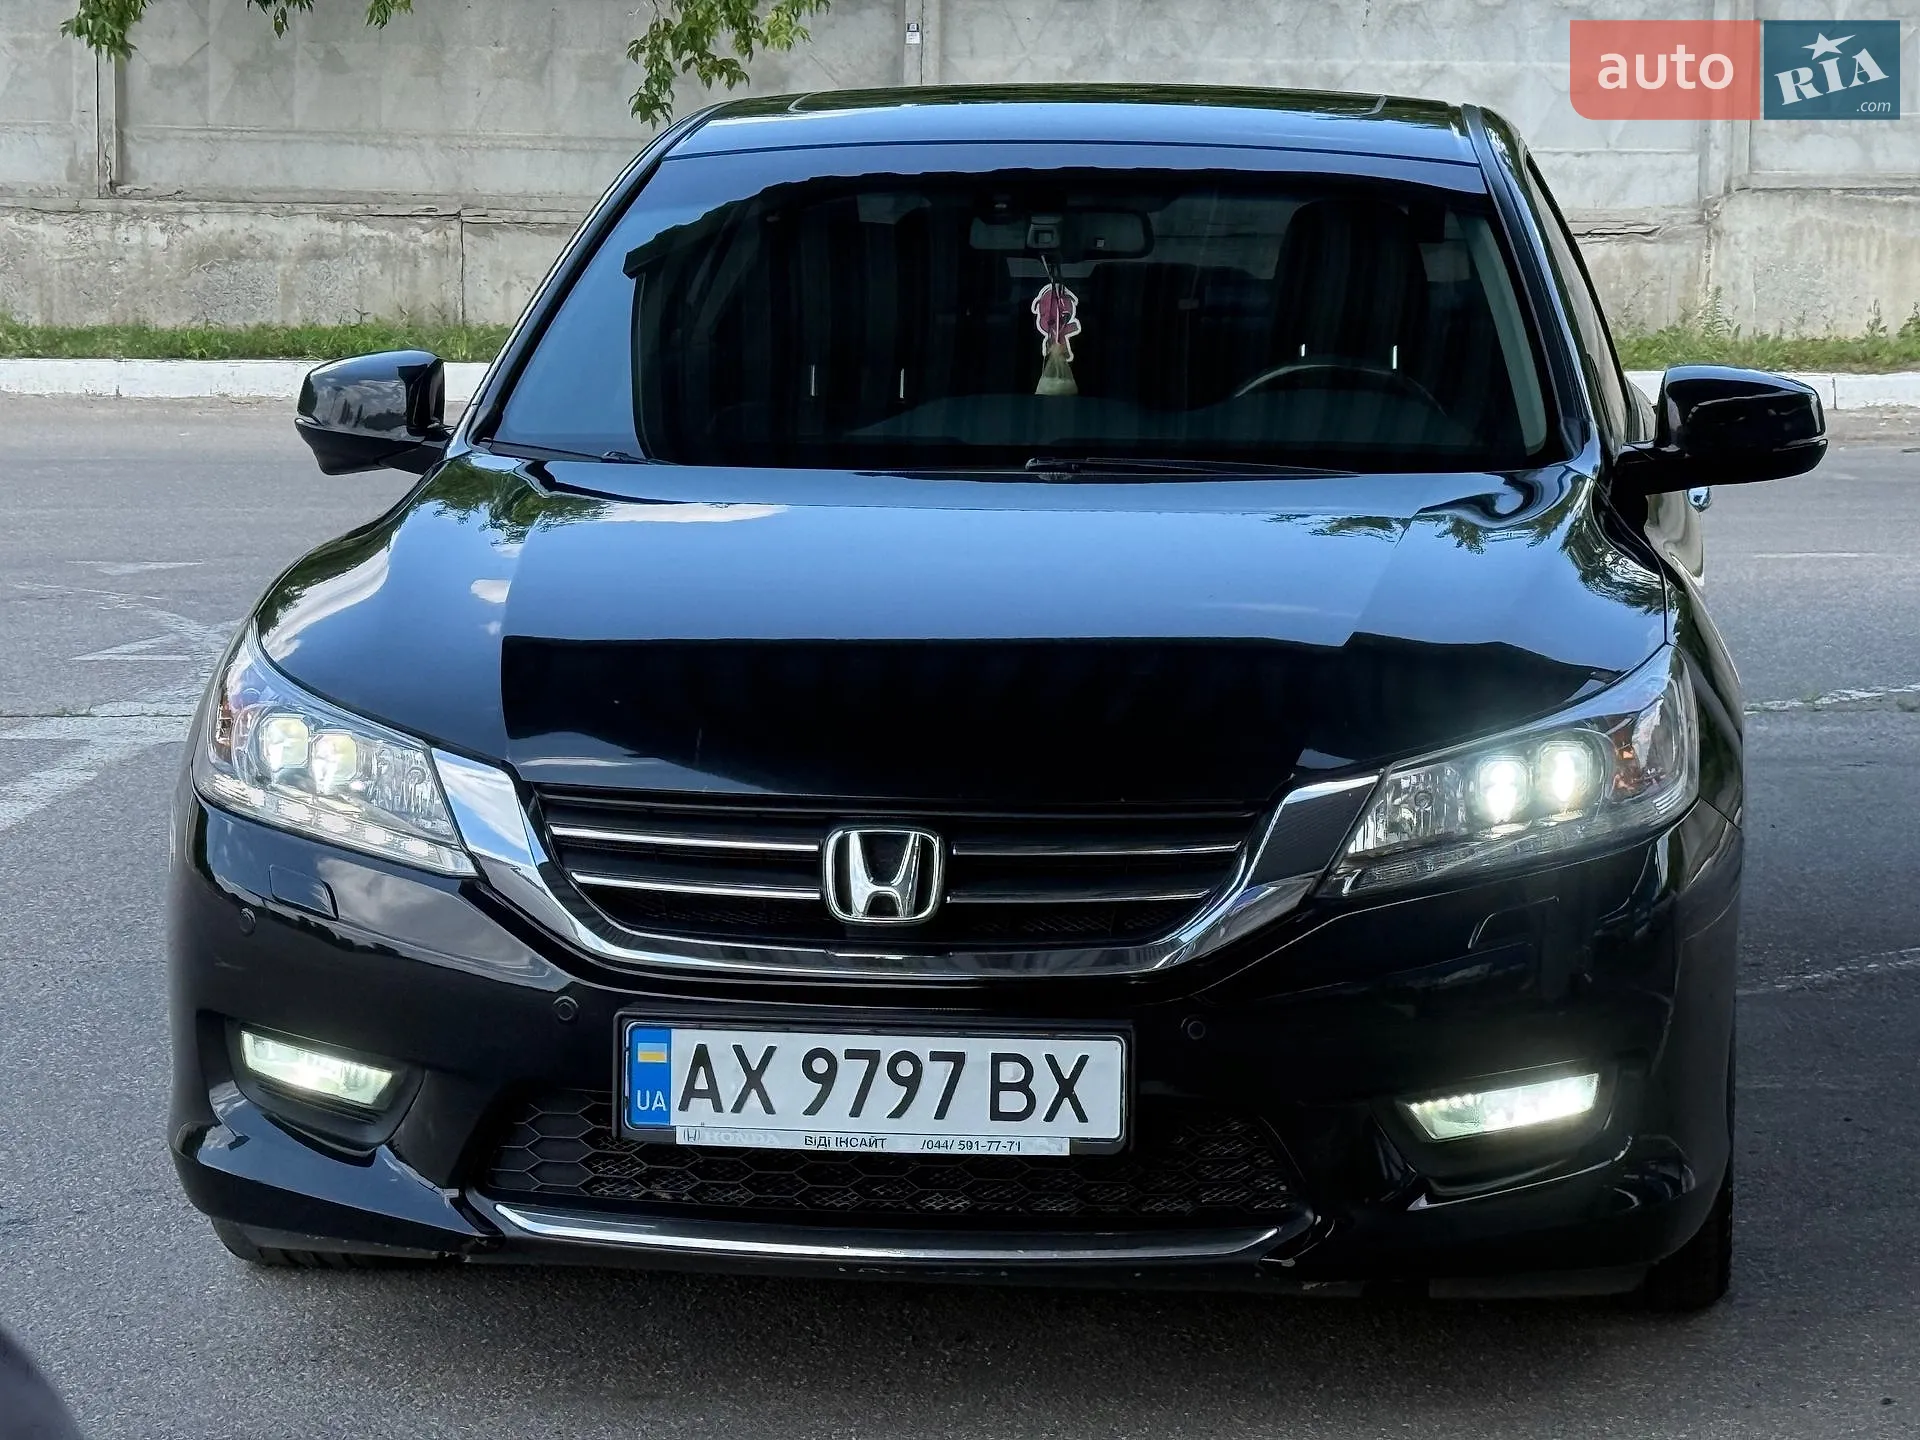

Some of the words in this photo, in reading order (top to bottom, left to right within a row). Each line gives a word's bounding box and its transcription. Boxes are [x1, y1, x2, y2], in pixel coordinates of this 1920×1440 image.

[636, 1089, 667, 1112] UA
[677, 1042, 777, 1115] AX
[801, 1047, 966, 1121] 9797
[989, 1052, 1090, 1124] BX
